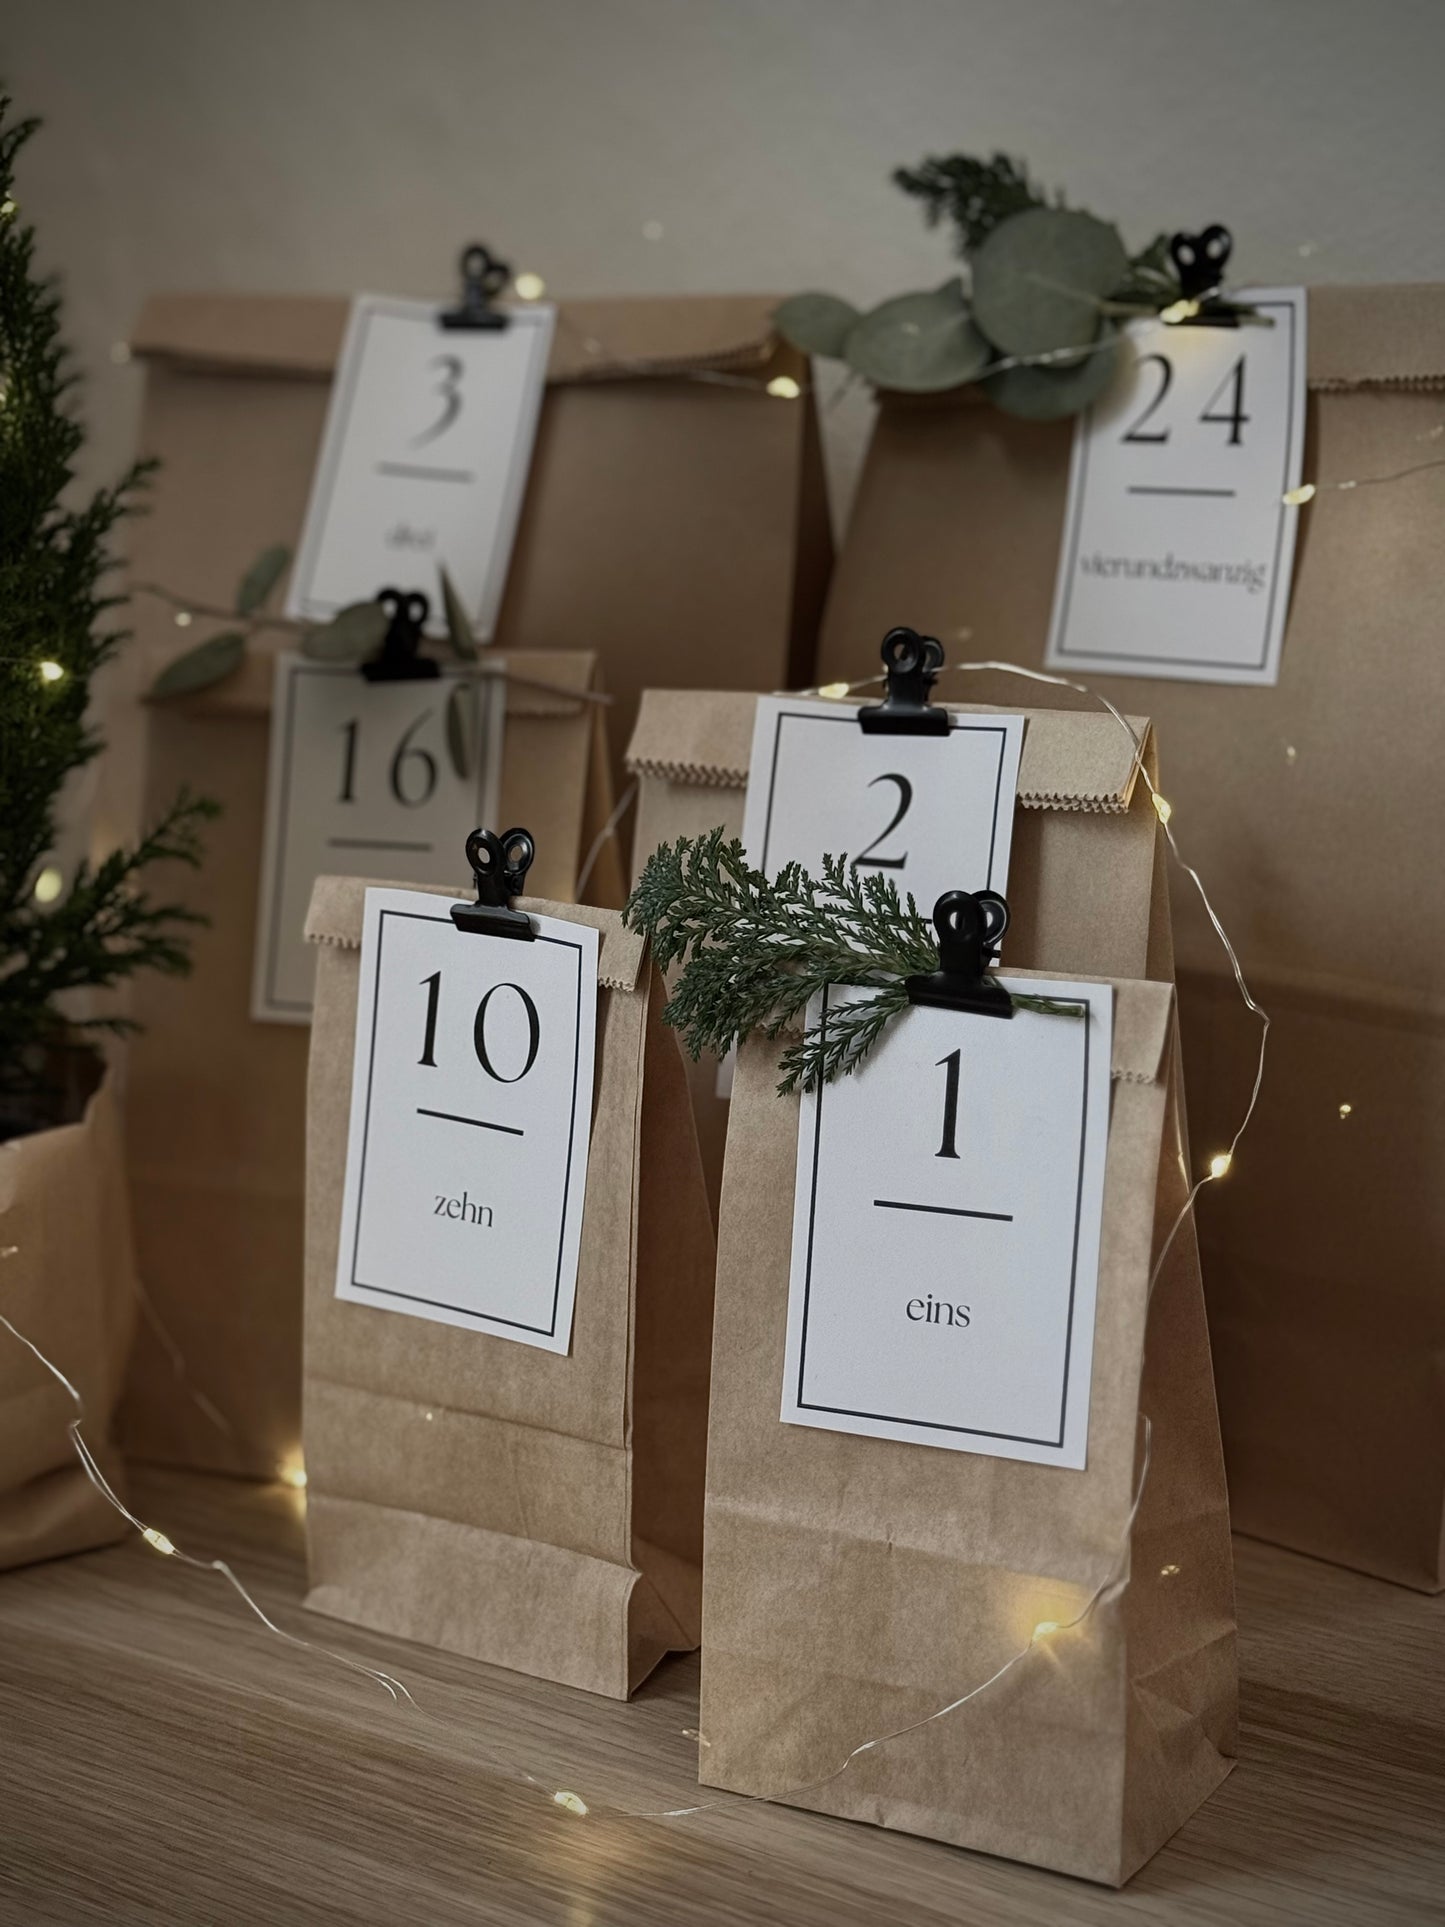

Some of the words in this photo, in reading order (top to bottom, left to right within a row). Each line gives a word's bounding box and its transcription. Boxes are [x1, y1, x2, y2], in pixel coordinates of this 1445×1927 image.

[410, 354, 464, 447] 3
[1120, 353, 1250, 448] 24
[337, 709, 439, 808] 16
[851, 773, 914, 870] 2
[416, 970, 541, 1084] 10
[934, 1048, 961, 1160] 1
[434, 1191, 494, 1229] zehn
[905, 1294, 972, 1328] eins
